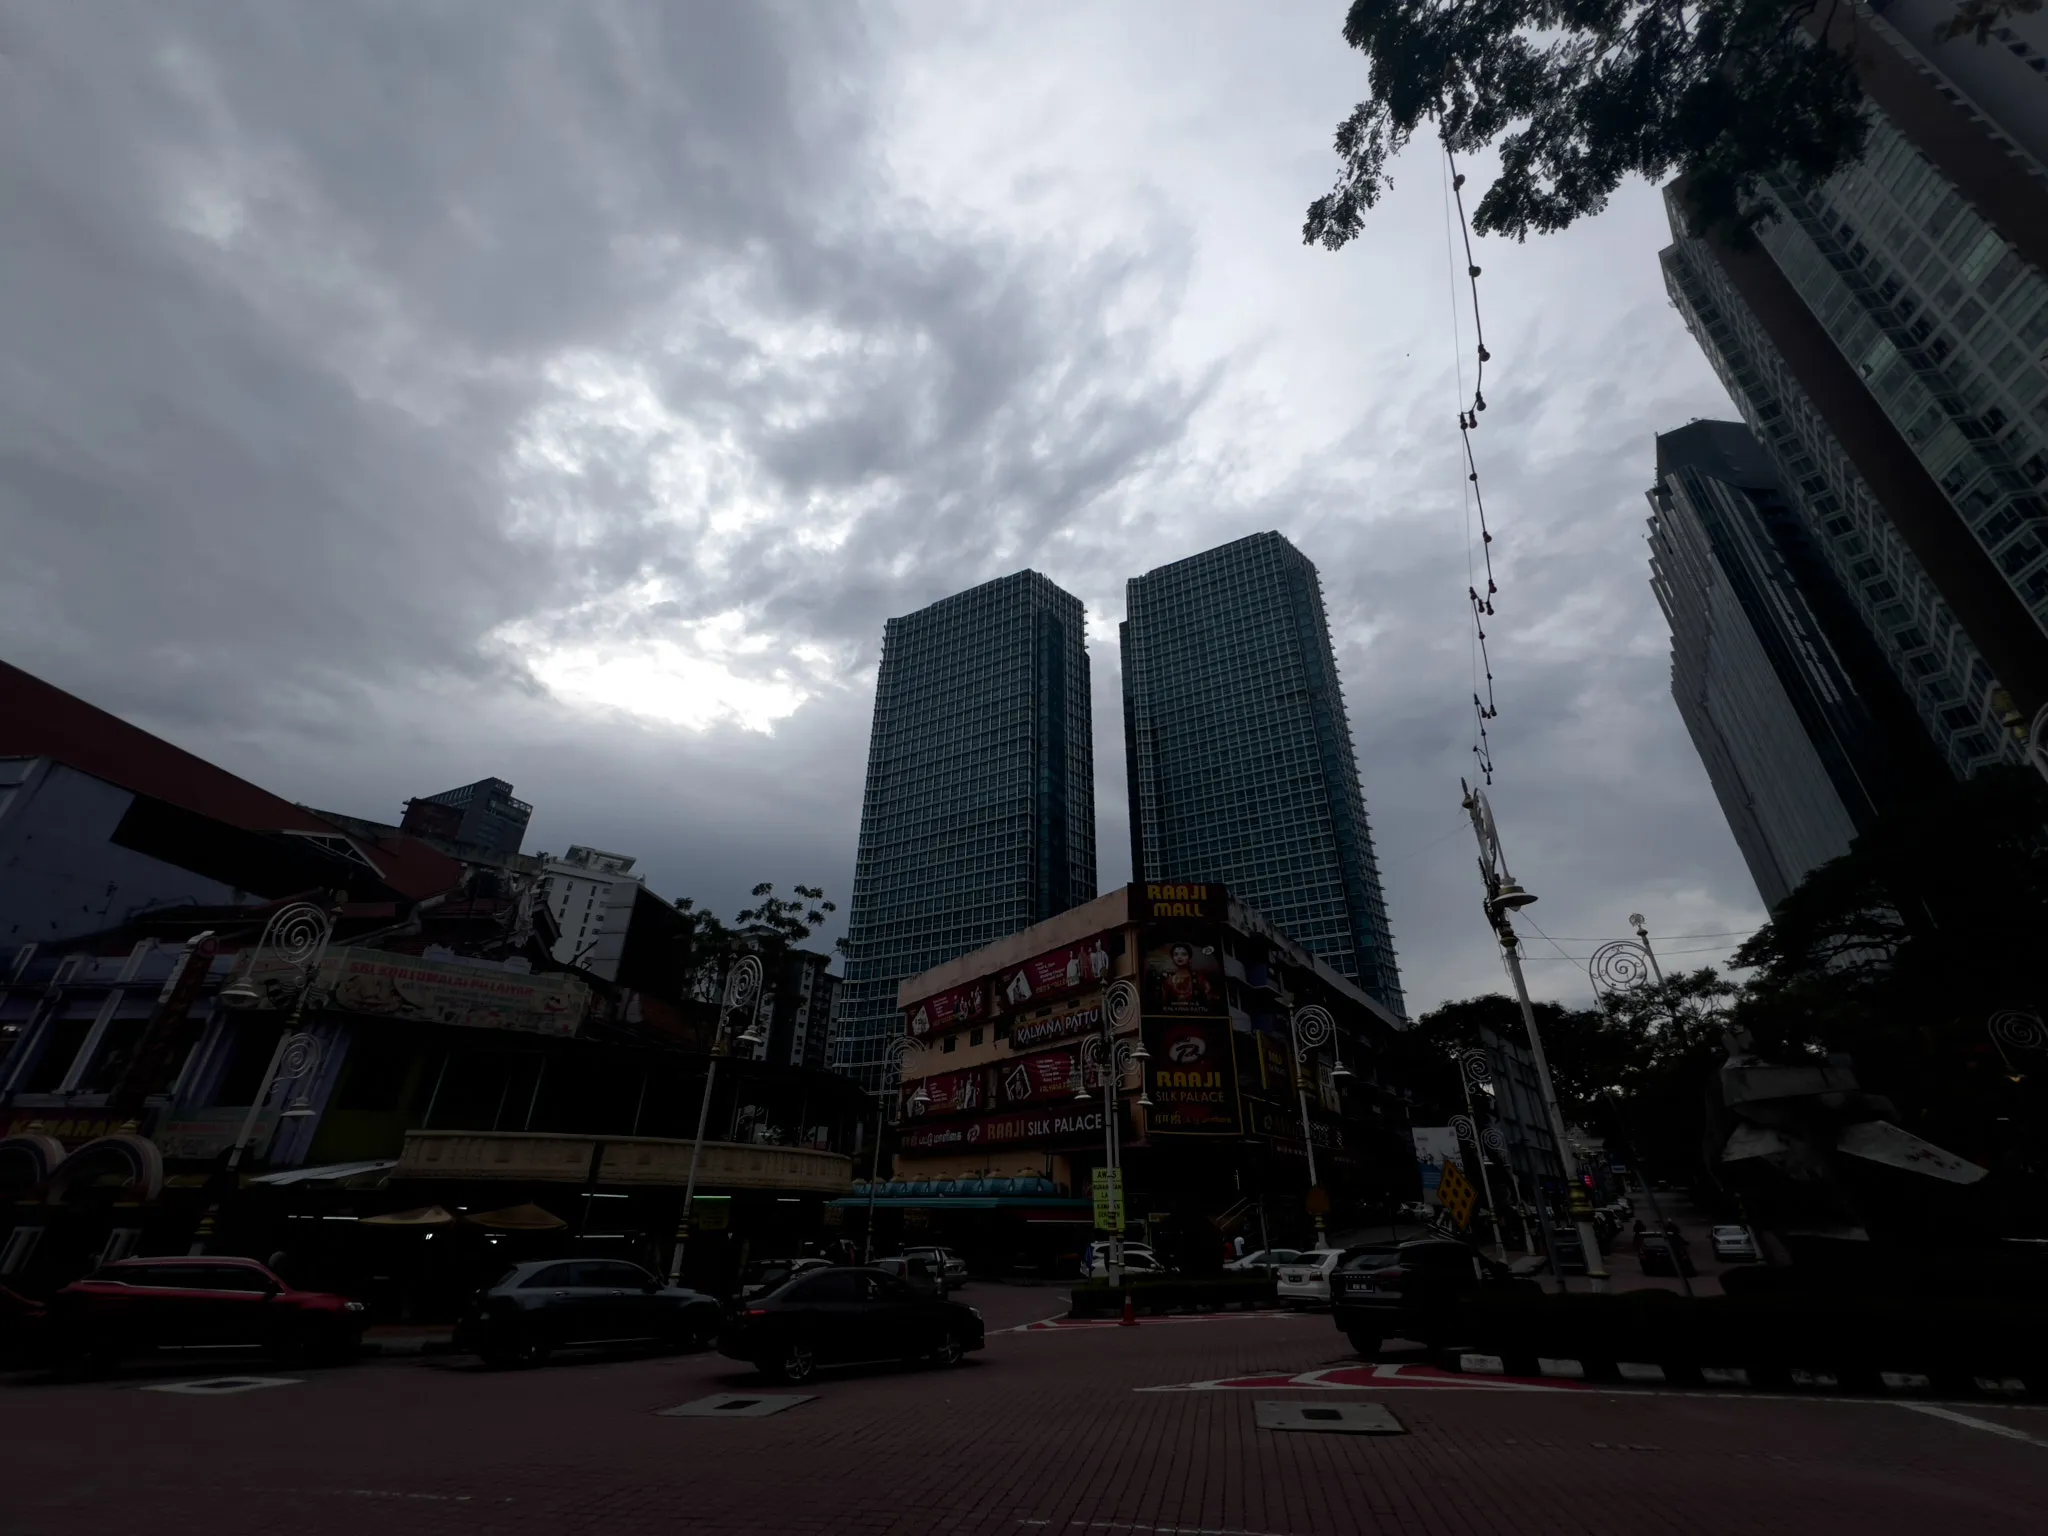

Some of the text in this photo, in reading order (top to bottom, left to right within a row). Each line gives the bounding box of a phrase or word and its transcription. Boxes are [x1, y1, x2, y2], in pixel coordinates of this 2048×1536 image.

[1147, 884, 1207, 901] RAAJI
[1153, 902, 1204, 918] MALL
[1017, 1008, 1099, 1044] KALYANA PATTU
[1156, 1071, 1222, 1088] RAAJI
[1155, 1090, 1226, 1103] SILK PALACE
[987, 1112, 1103, 1140] RAAJI SILK PALACE
[1097, 1170, 1117, 1179] AWS
